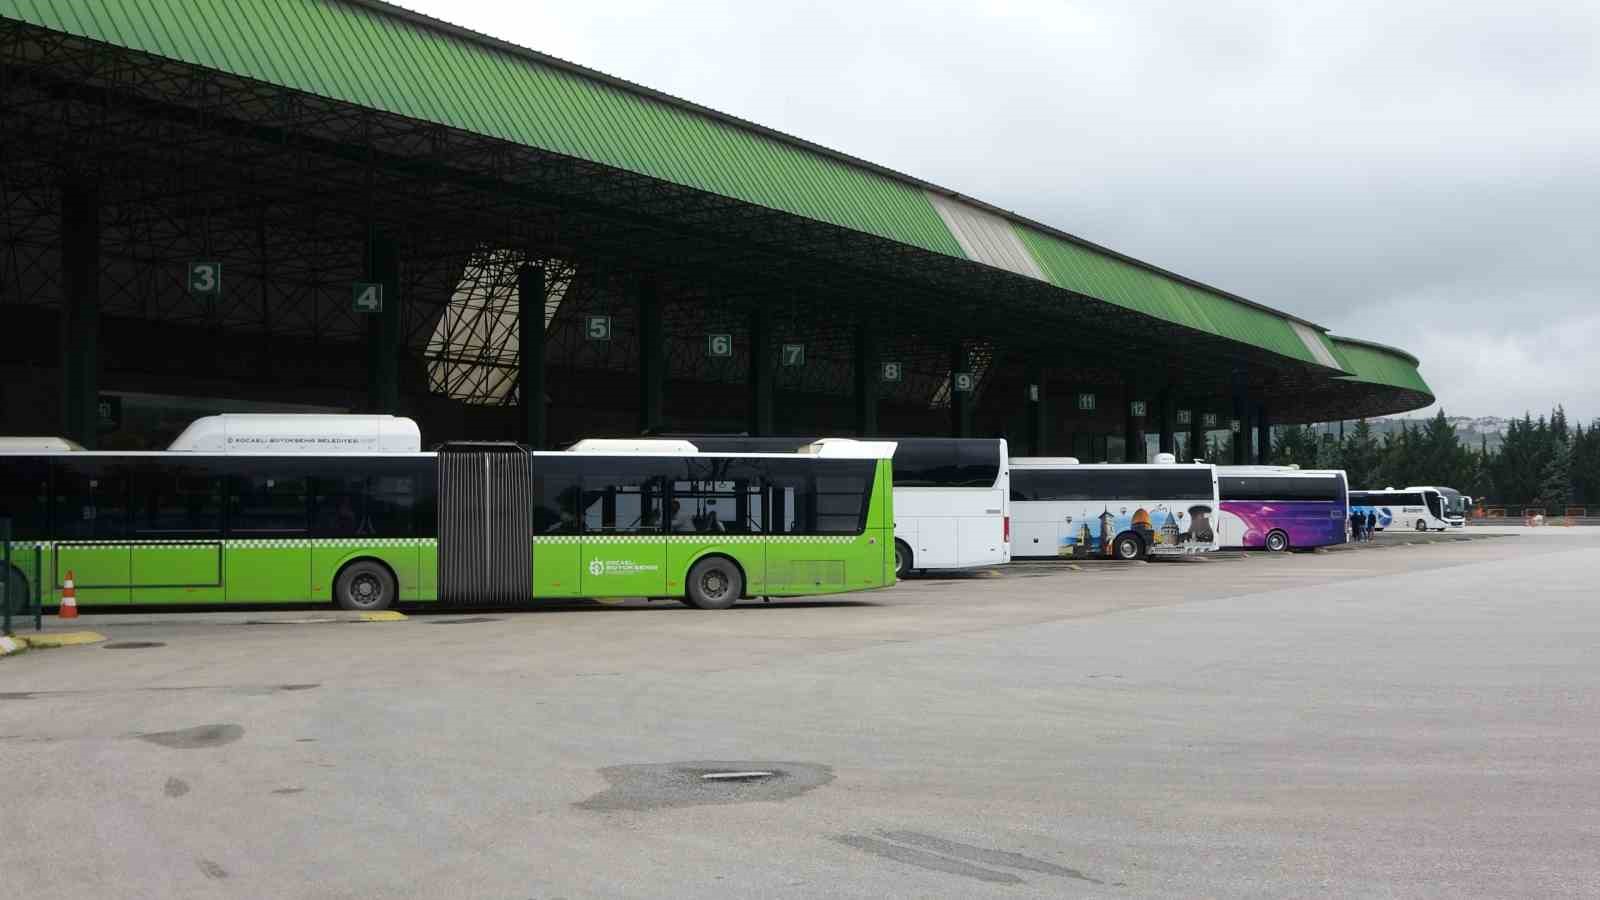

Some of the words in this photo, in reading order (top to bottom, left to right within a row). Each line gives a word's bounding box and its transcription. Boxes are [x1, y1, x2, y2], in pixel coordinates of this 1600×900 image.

[193, 265, 215, 291] 3
[357, 286, 378, 310] 4
[590, 318, 607, 338] 5
[712, 336, 728, 354] 6
[786, 345, 800, 363] 7
[885, 364, 898, 379] 8
[958, 375, 970, 389] 9
